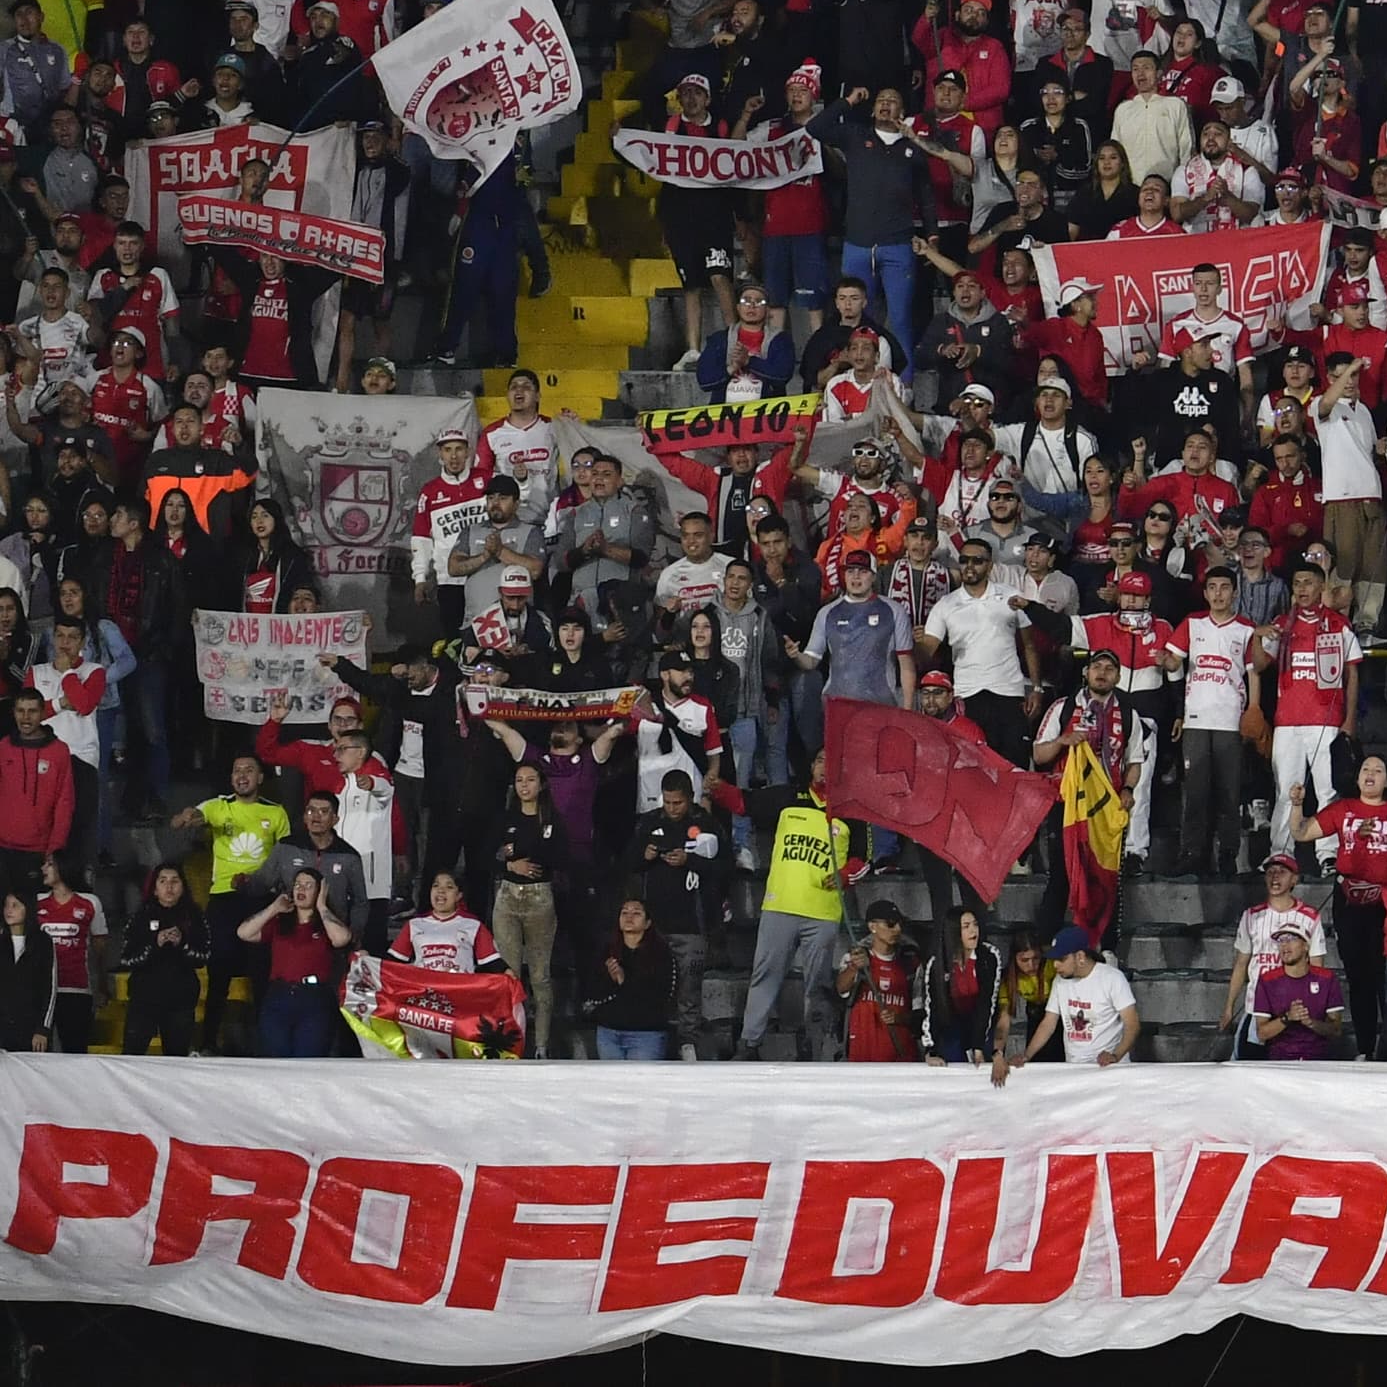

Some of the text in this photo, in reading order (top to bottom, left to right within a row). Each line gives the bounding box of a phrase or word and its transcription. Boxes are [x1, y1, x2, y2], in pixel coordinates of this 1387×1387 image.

[490, 59, 514, 109] SANTA
[180, 203, 274, 235] BUENOS
[1159, 273, 1194, 293] SANT
[752, 400, 792, 435] 10
[1174, 404, 1209, 418] Kappa
[227, 616, 261, 648] CRIS
[1196, 656, 1232, 670] Colanta
[1192, 672, 1229, 687] BetPlay
[782, 846, 831, 871] AGUILA
[398, 1006, 453, 1033] SANTA FE
[6, 1122, 772, 1314] PROFE
